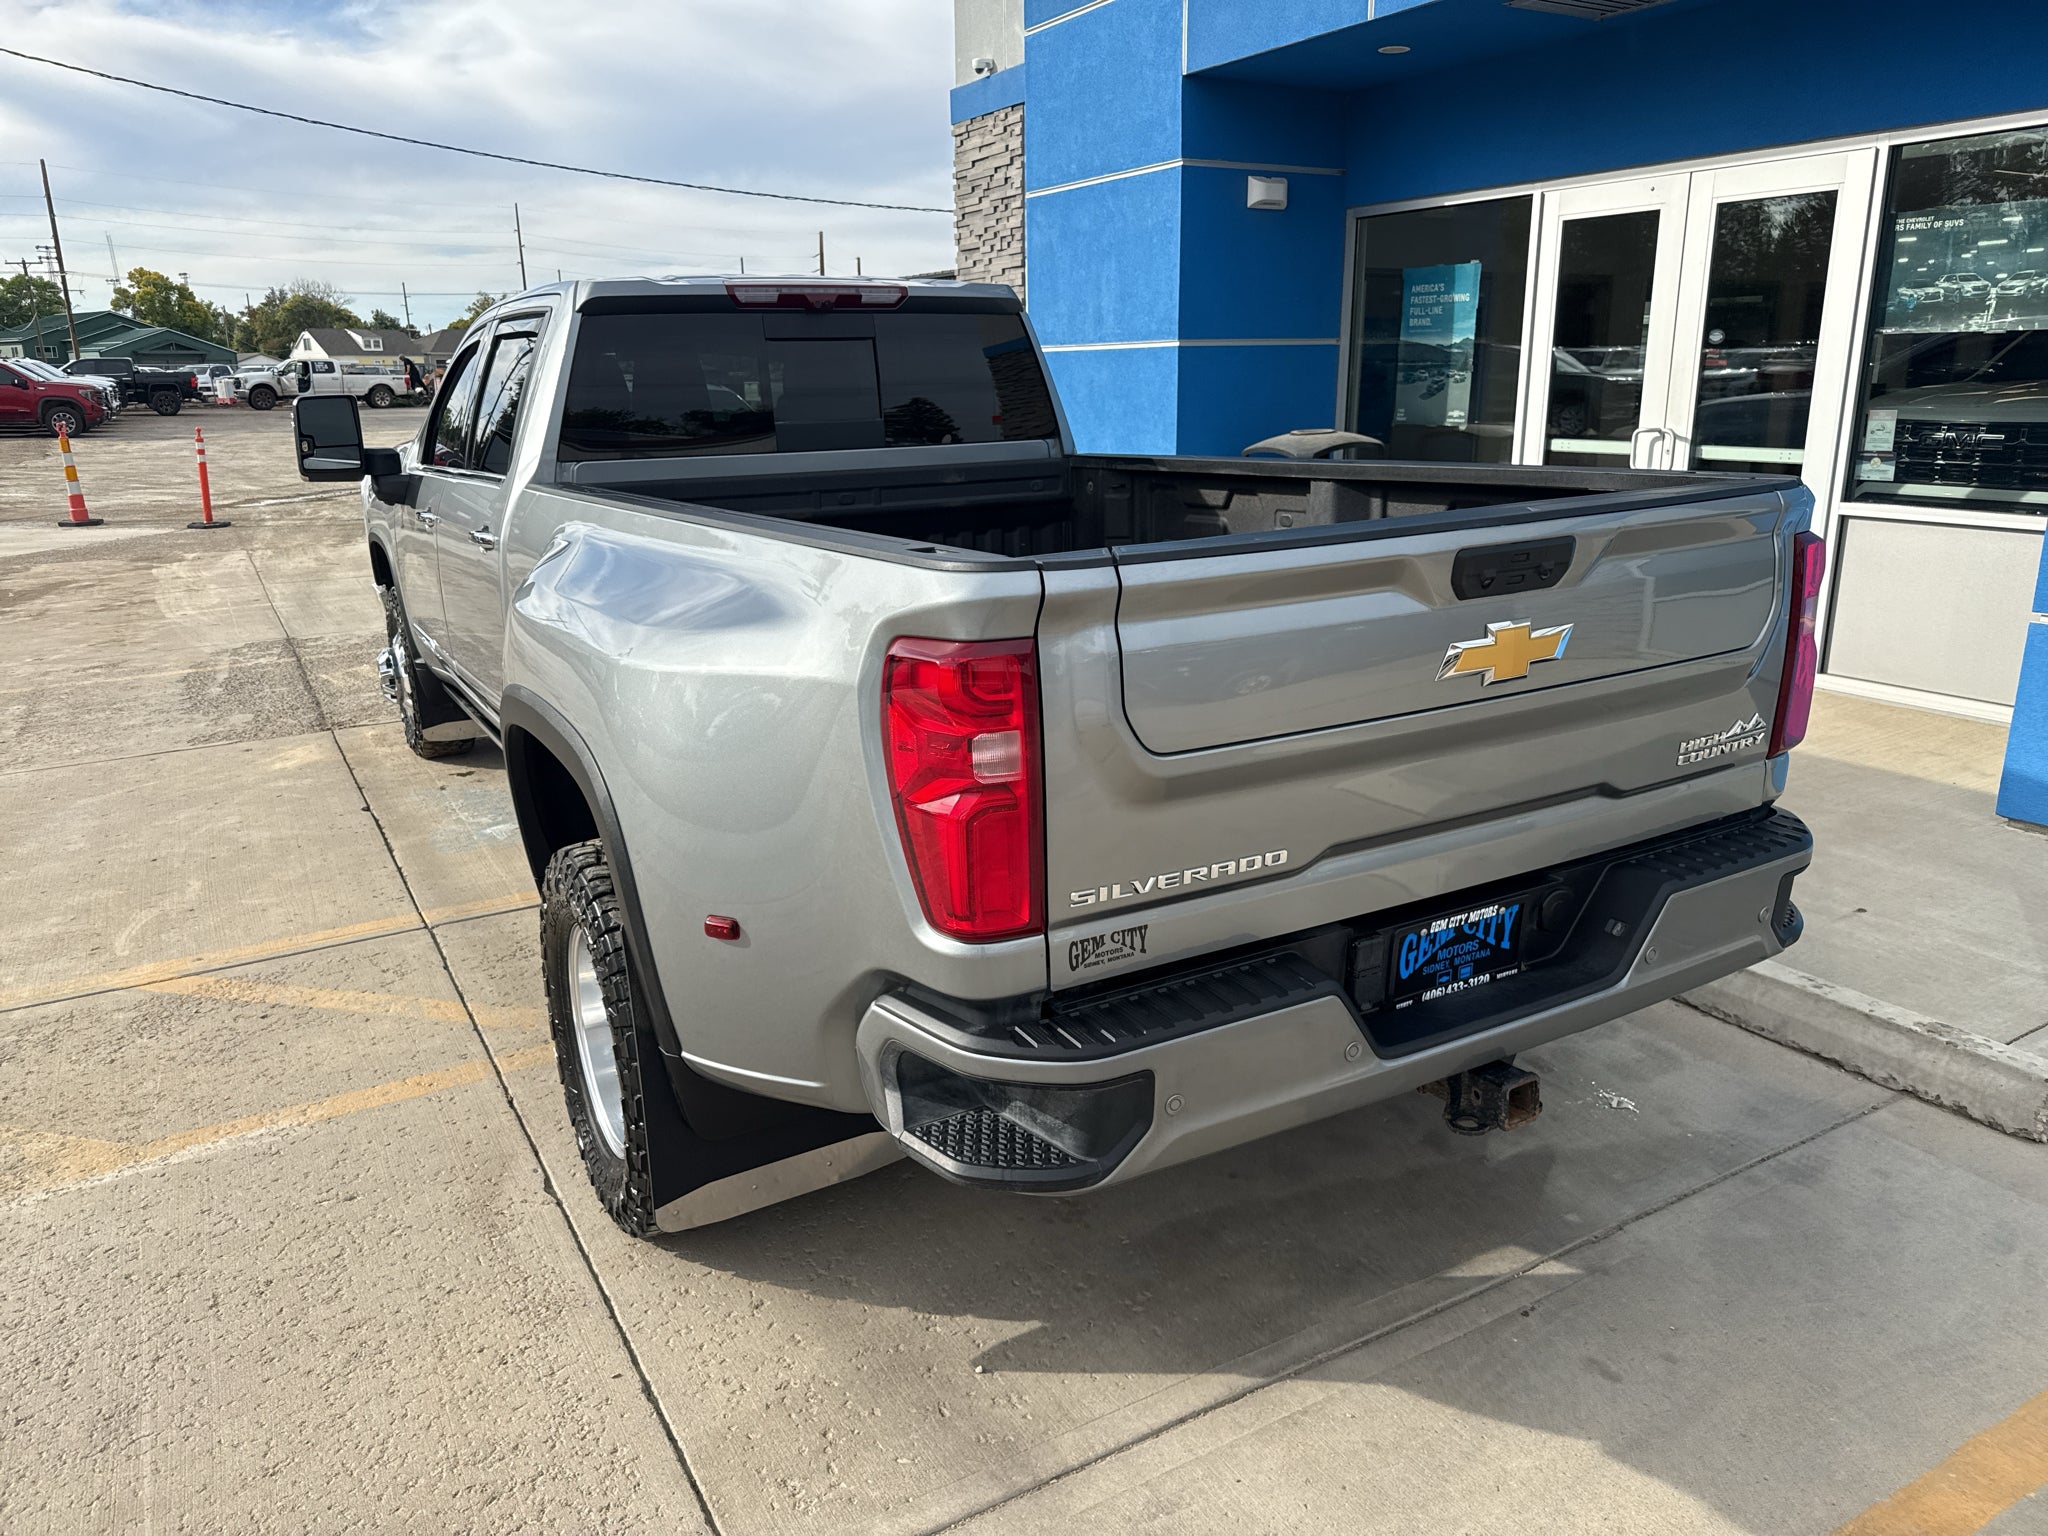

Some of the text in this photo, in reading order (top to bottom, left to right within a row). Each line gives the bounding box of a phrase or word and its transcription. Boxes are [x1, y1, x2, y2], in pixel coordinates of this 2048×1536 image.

[1906, 222, 1932, 231] FAMILY
[1934, 220, 1943, 228] OF
[1411, 283, 1445, 293] AMERICA'S
[1410, 293, 1470, 304] FASTEST-GROWING
[1409, 306, 1443, 316] FULL-LINE
[1920, 432, 2005, 451] GMC
[1677, 732, 1765, 766] COUNTRY
[1679, 732, 1727, 754] HIGH
[1070, 849, 1288, 908] SILVERADO
[1430, 905, 1498, 934] GEM CITY MOTORS
[1069, 924, 1148, 972] GEM CITY
[1095, 947, 1123, 959] MOTORS
[1437, 940, 1480, 961] MOTORS
[1453, 949, 1491, 966] MONTANA
